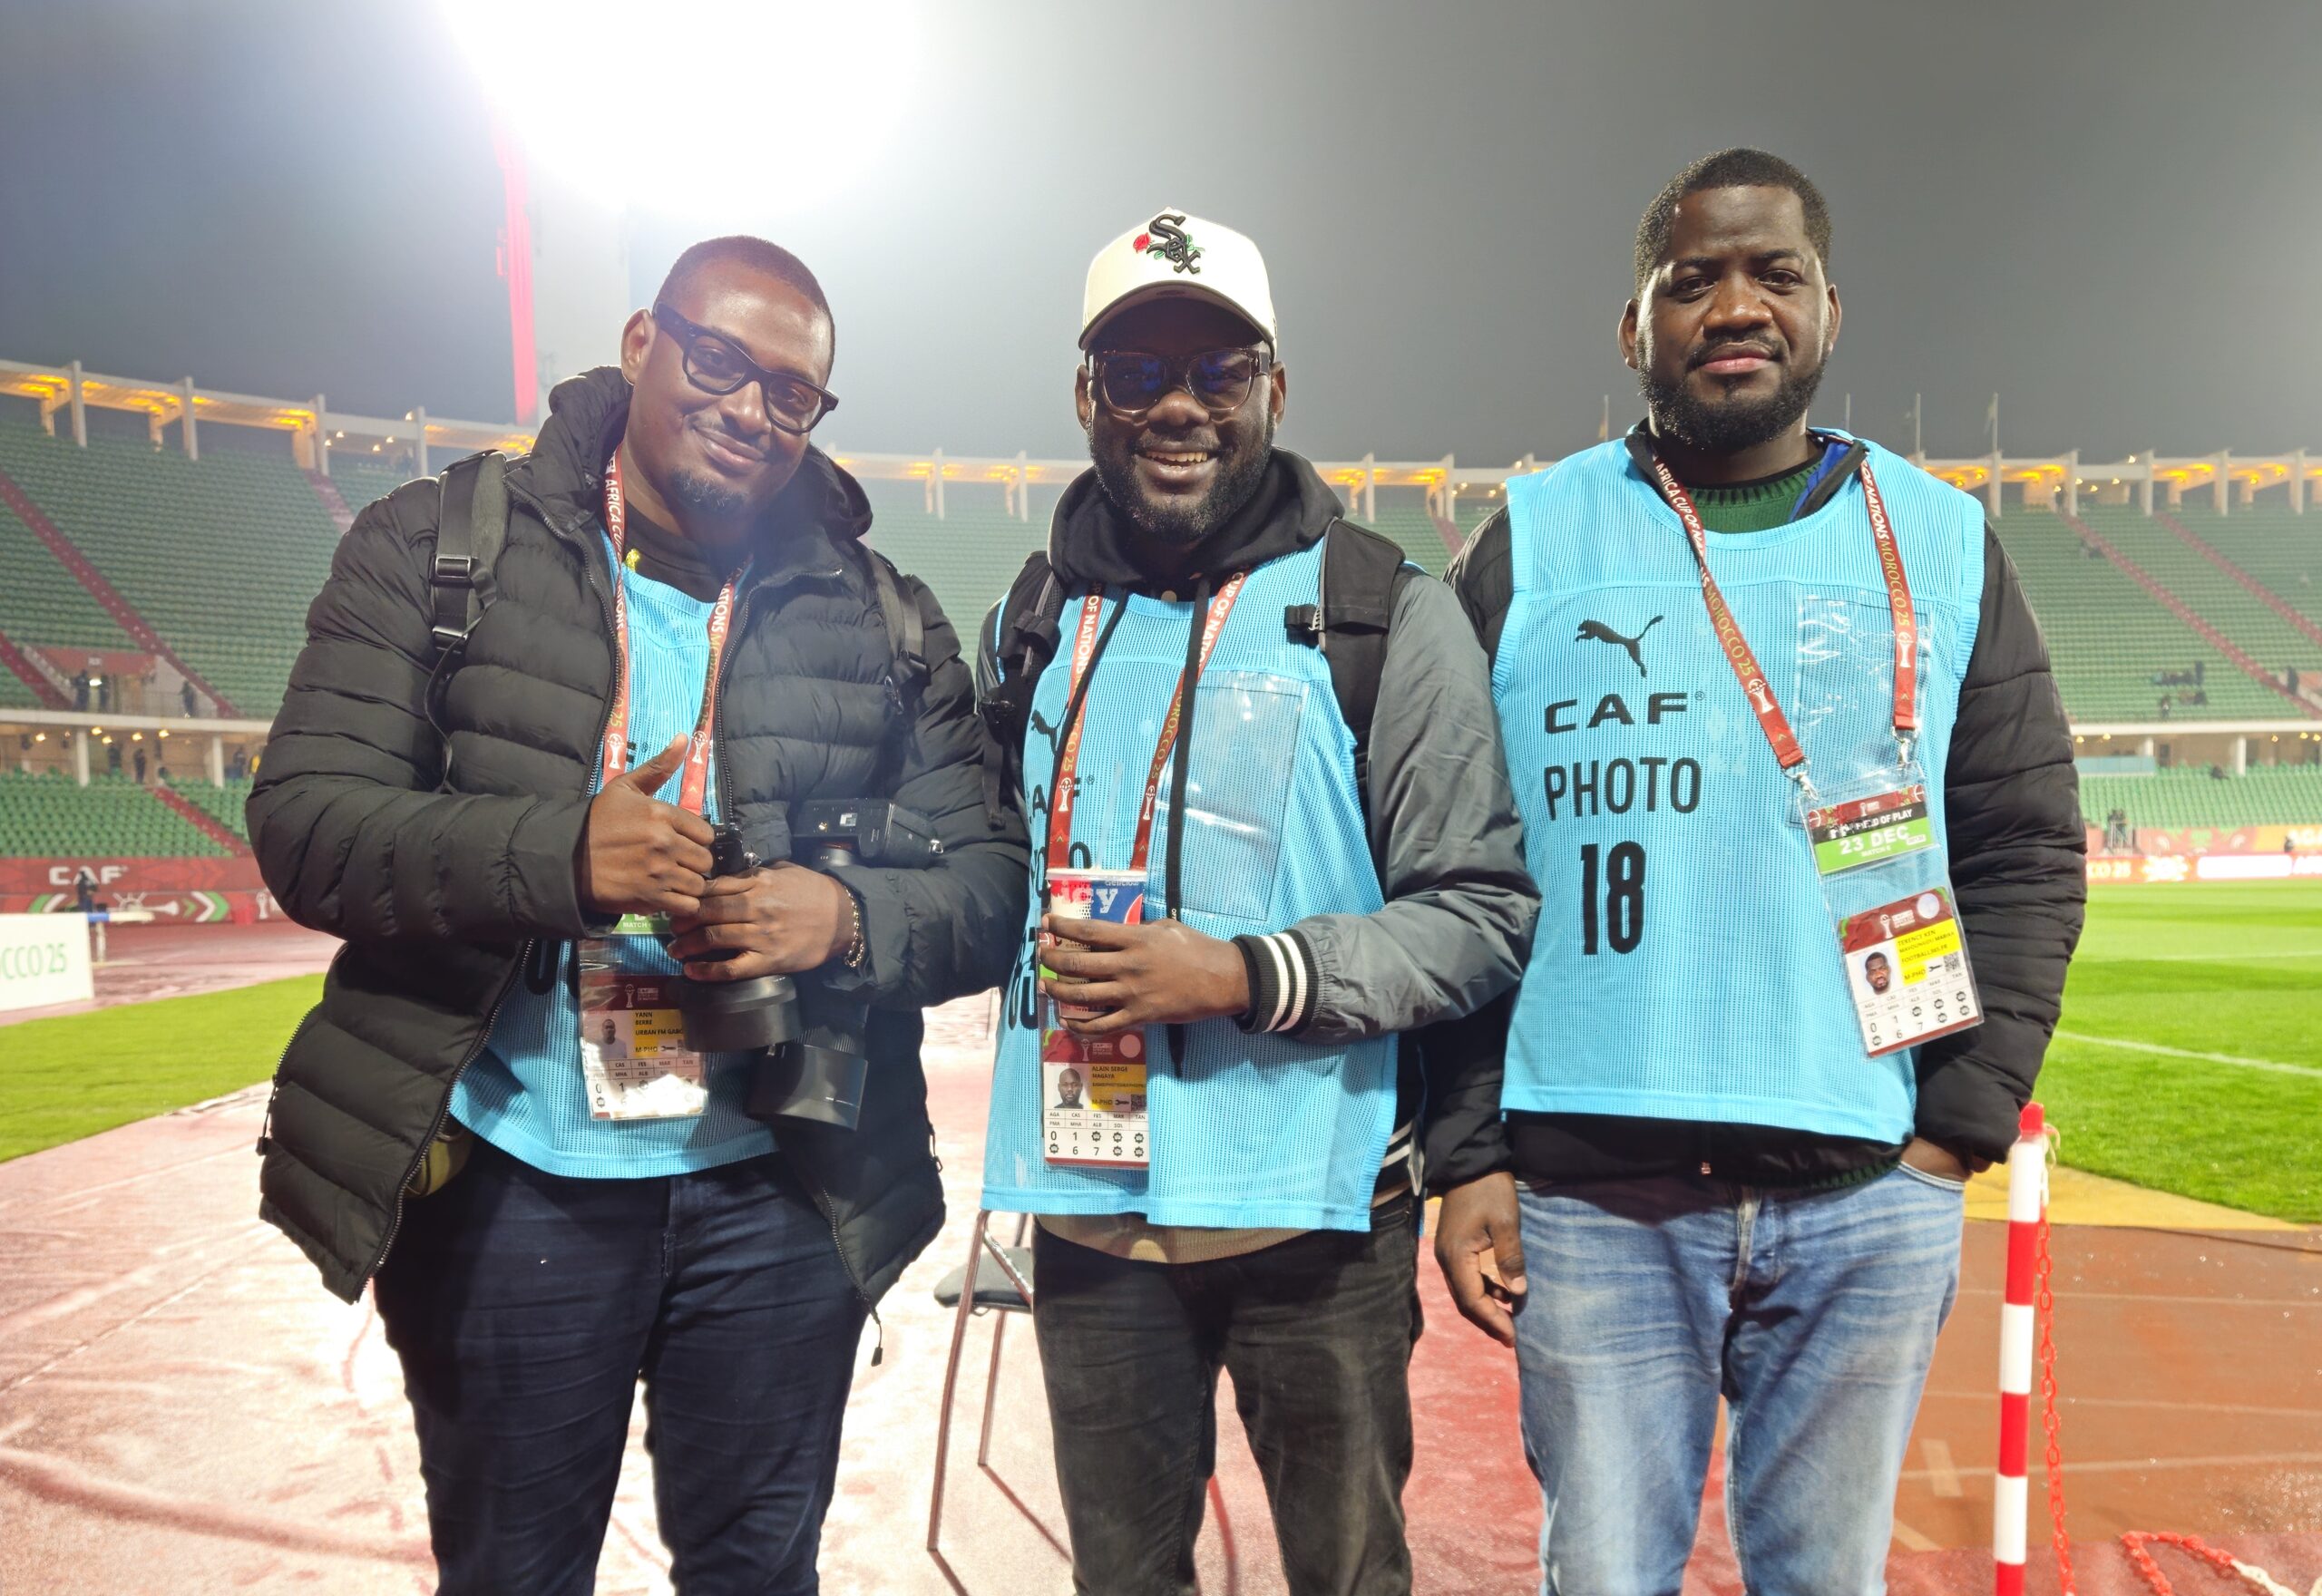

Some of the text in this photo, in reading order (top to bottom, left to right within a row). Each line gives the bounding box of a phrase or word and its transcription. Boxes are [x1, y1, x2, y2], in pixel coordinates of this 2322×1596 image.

[604, 479, 621, 523] AFRICA
[1865, 485, 1889, 540] NATIONS
[1880, 540, 1907, 611] MOROCCO
[1896, 610, 1910, 626] 25
[1655, 462, 1680, 502] AFRICA
[1673, 497, 1693, 515] CUP
[1683, 513, 1699, 530] OF
[1705, 585, 1744, 658] MOROCCO
[1738, 658, 1755, 676] 25
[1225, 572, 1245, 598] CUP
[1087, 595, 1099, 612] OF
[1215, 600, 1231, 619] OF
[1545, 692, 1688, 735] CAF
[1063, 755, 1075, 772] 25
[1151, 764, 1162, 779] 25
[1544, 756, 1702, 822] PHOTO
[1880, 814, 1891, 823] OF
[1893, 809, 1913, 822] PLAY
[1839, 837, 1864, 854] 23
[1870, 825, 1909, 847] DEC
[49, 866, 123, 885] CAF
[1580, 840, 1647, 956] 18
[45, 942, 68, 974] 25
[1870, 1015, 1898, 1033] 0 1
[1896, 1022, 1923, 1039] 6 7
[619, 1082, 625, 1092] 1
[1050, 1131, 1078, 1141] 0 1
[1072, 1146, 1100, 1156] 6 7
